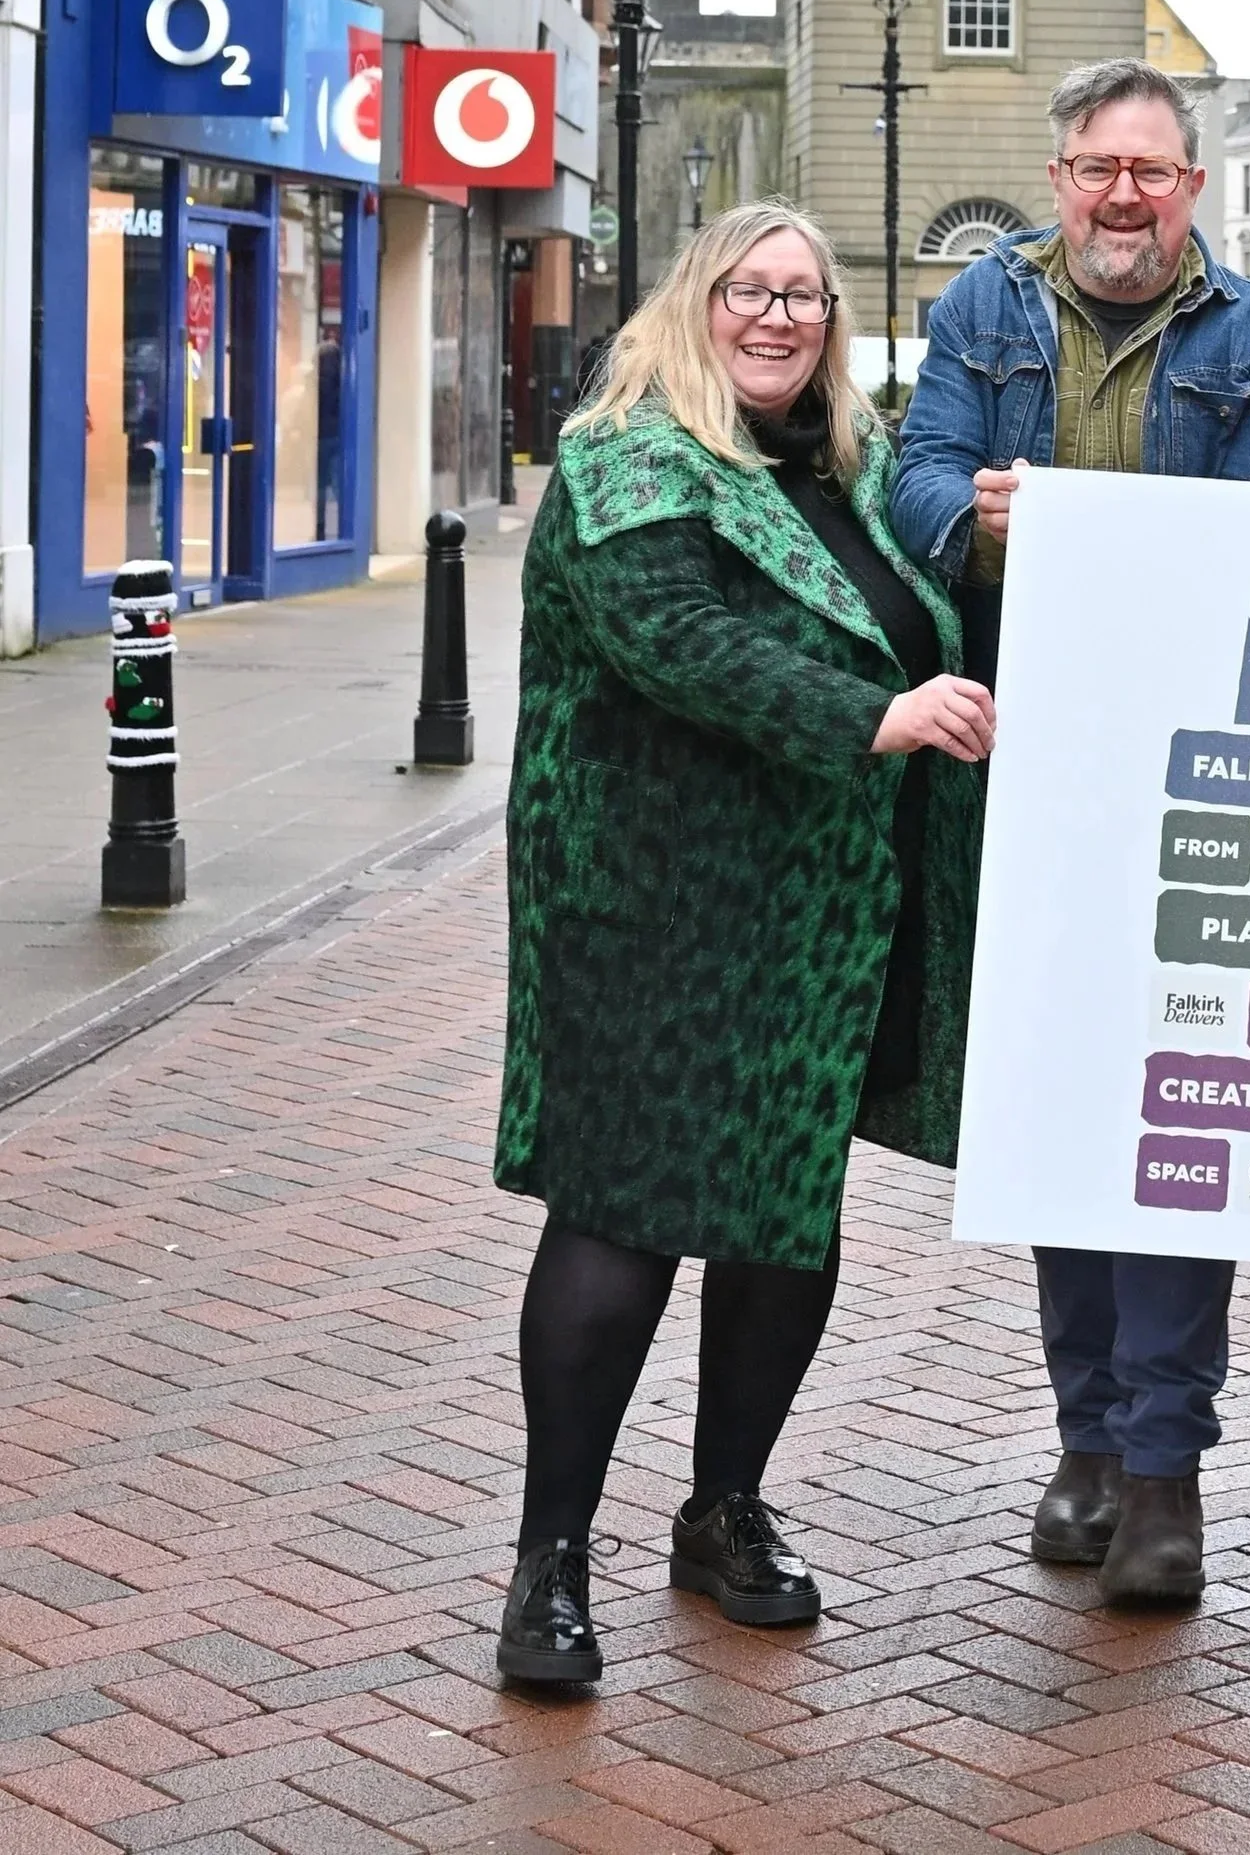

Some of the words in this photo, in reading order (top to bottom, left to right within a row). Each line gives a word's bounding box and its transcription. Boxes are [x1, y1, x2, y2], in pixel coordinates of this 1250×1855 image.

[1173, 837, 1240, 860] FROM
[1166, 993, 1225, 1013] Falkirk
[1163, 1008, 1225, 1026] Delivers
[1146, 1161, 1220, 1184] SPACE
